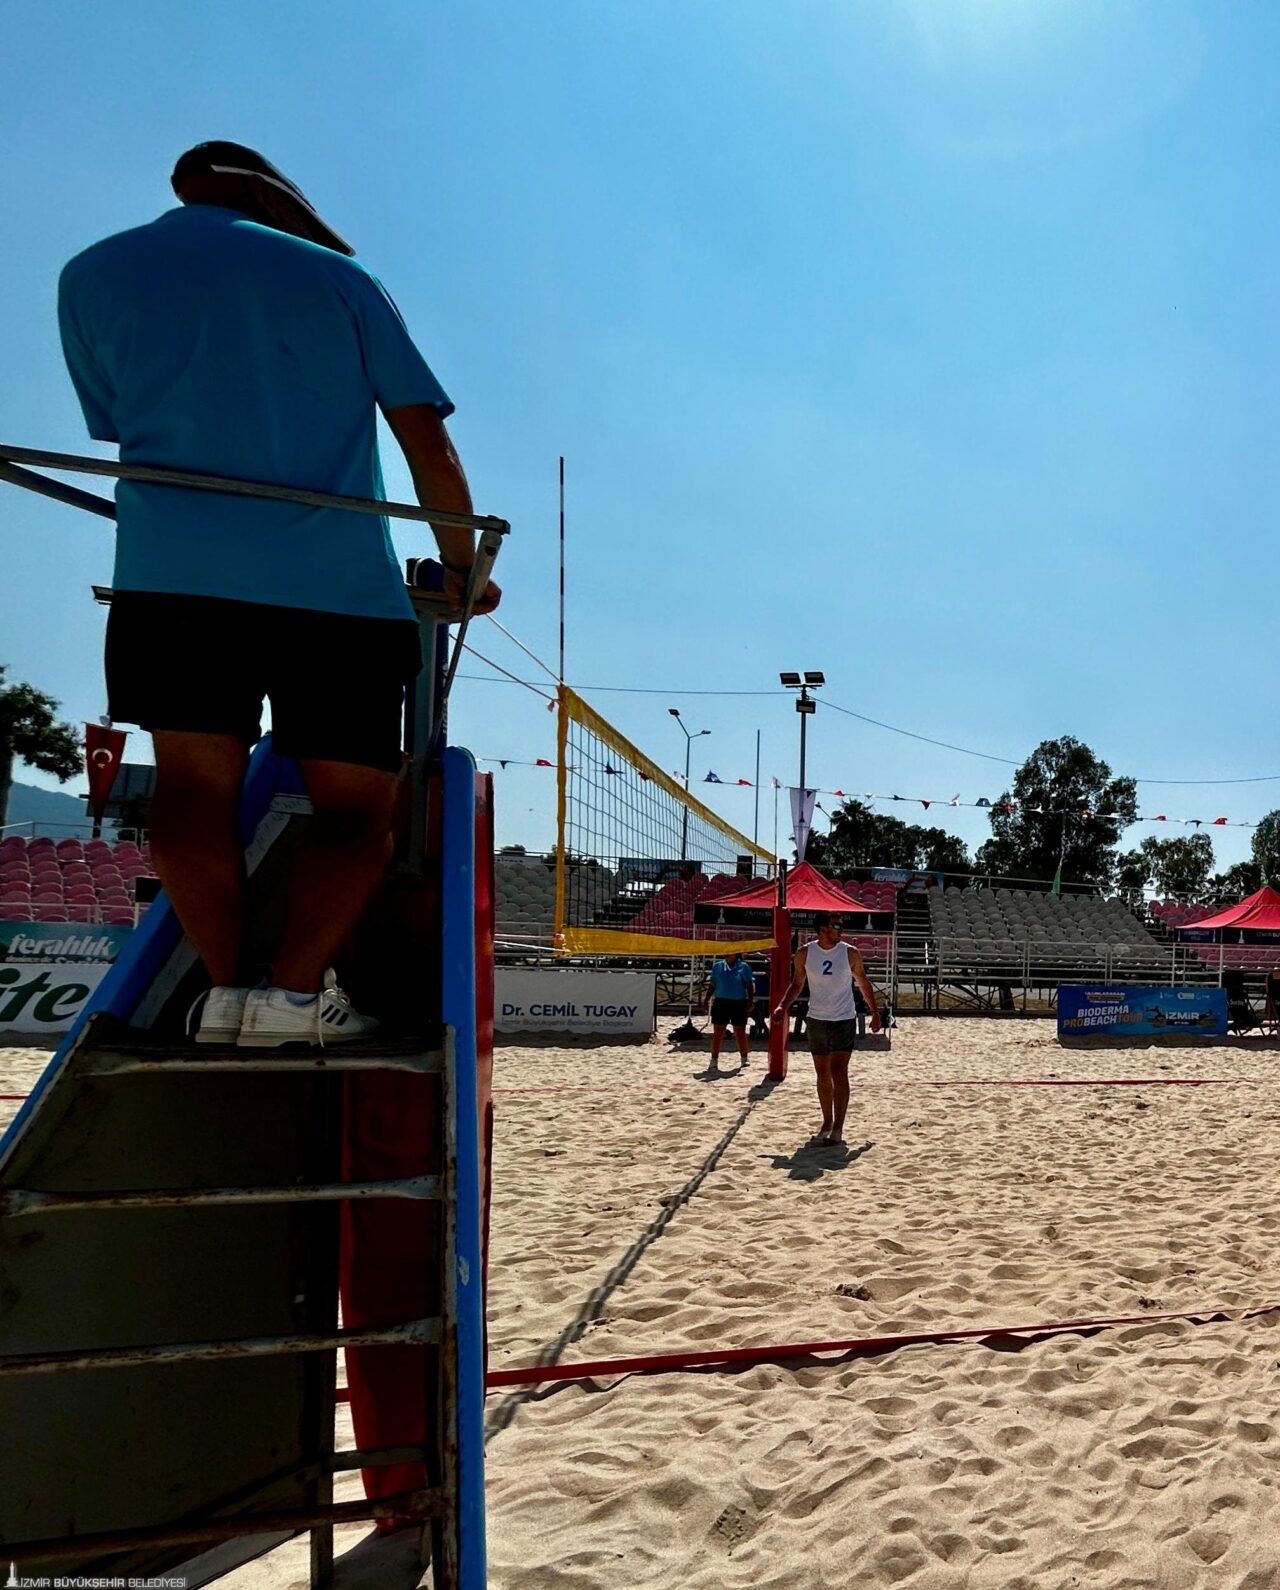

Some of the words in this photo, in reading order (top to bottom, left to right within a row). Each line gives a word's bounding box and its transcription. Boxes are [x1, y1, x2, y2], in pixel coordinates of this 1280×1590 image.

[822, 960, 833, 975] 2
[502, 1003, 525, 1016] Dr.
[530, 1002, 580, 1017] CEMİL
[584, 1005, 638, 1018] TUGAY
[1077, 1005, 1129, 1018] BIODERMA
